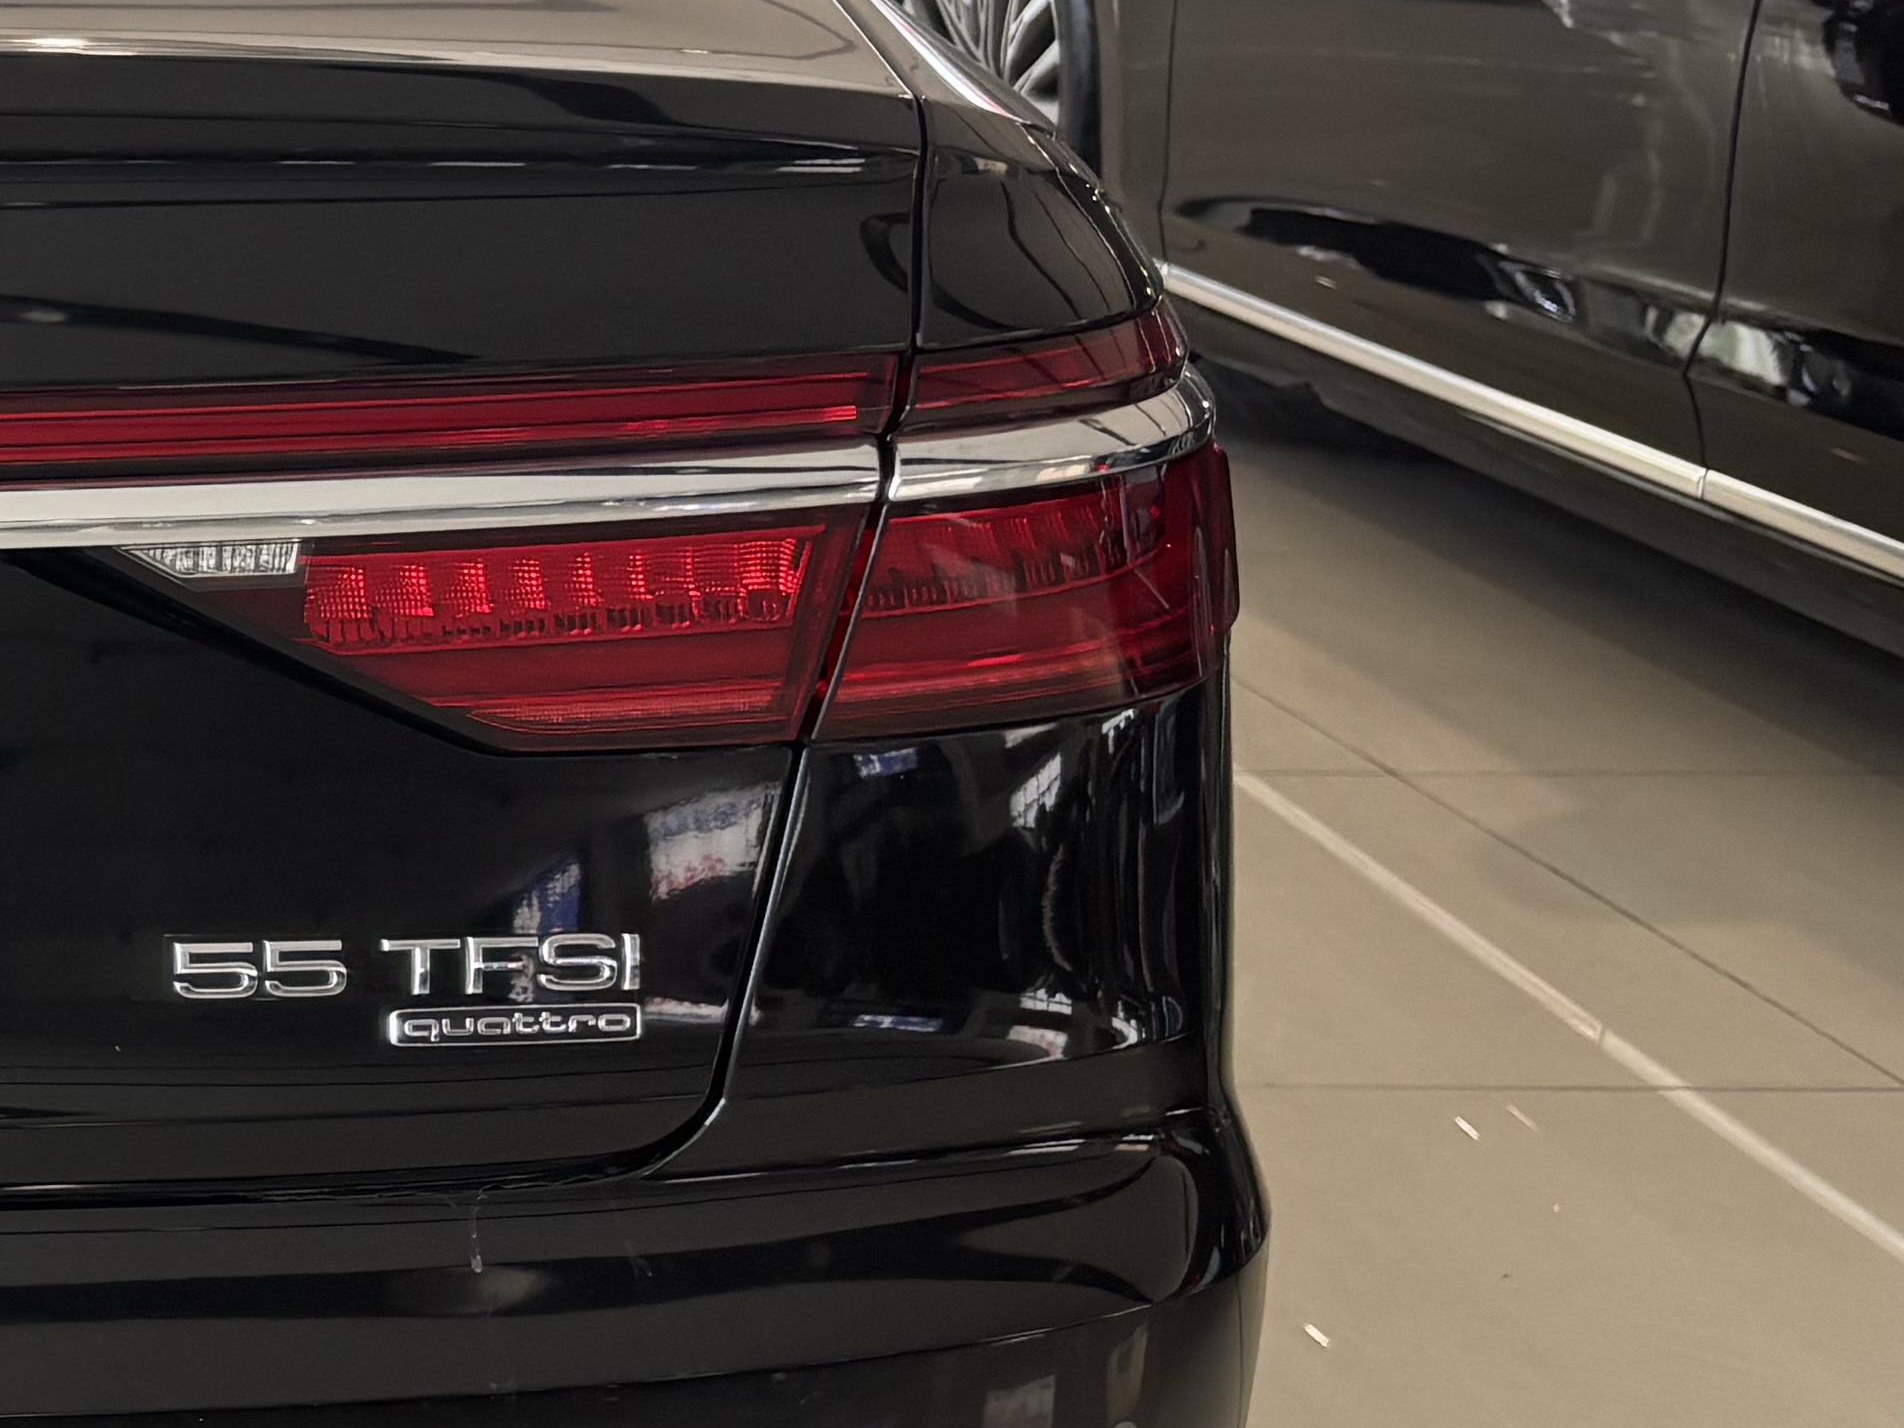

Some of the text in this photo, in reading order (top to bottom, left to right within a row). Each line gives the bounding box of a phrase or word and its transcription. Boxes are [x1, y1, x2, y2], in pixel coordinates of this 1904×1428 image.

[172, 932, 641, 999] 55 TFSI
[403, 1011, 633, 1042] quattro
